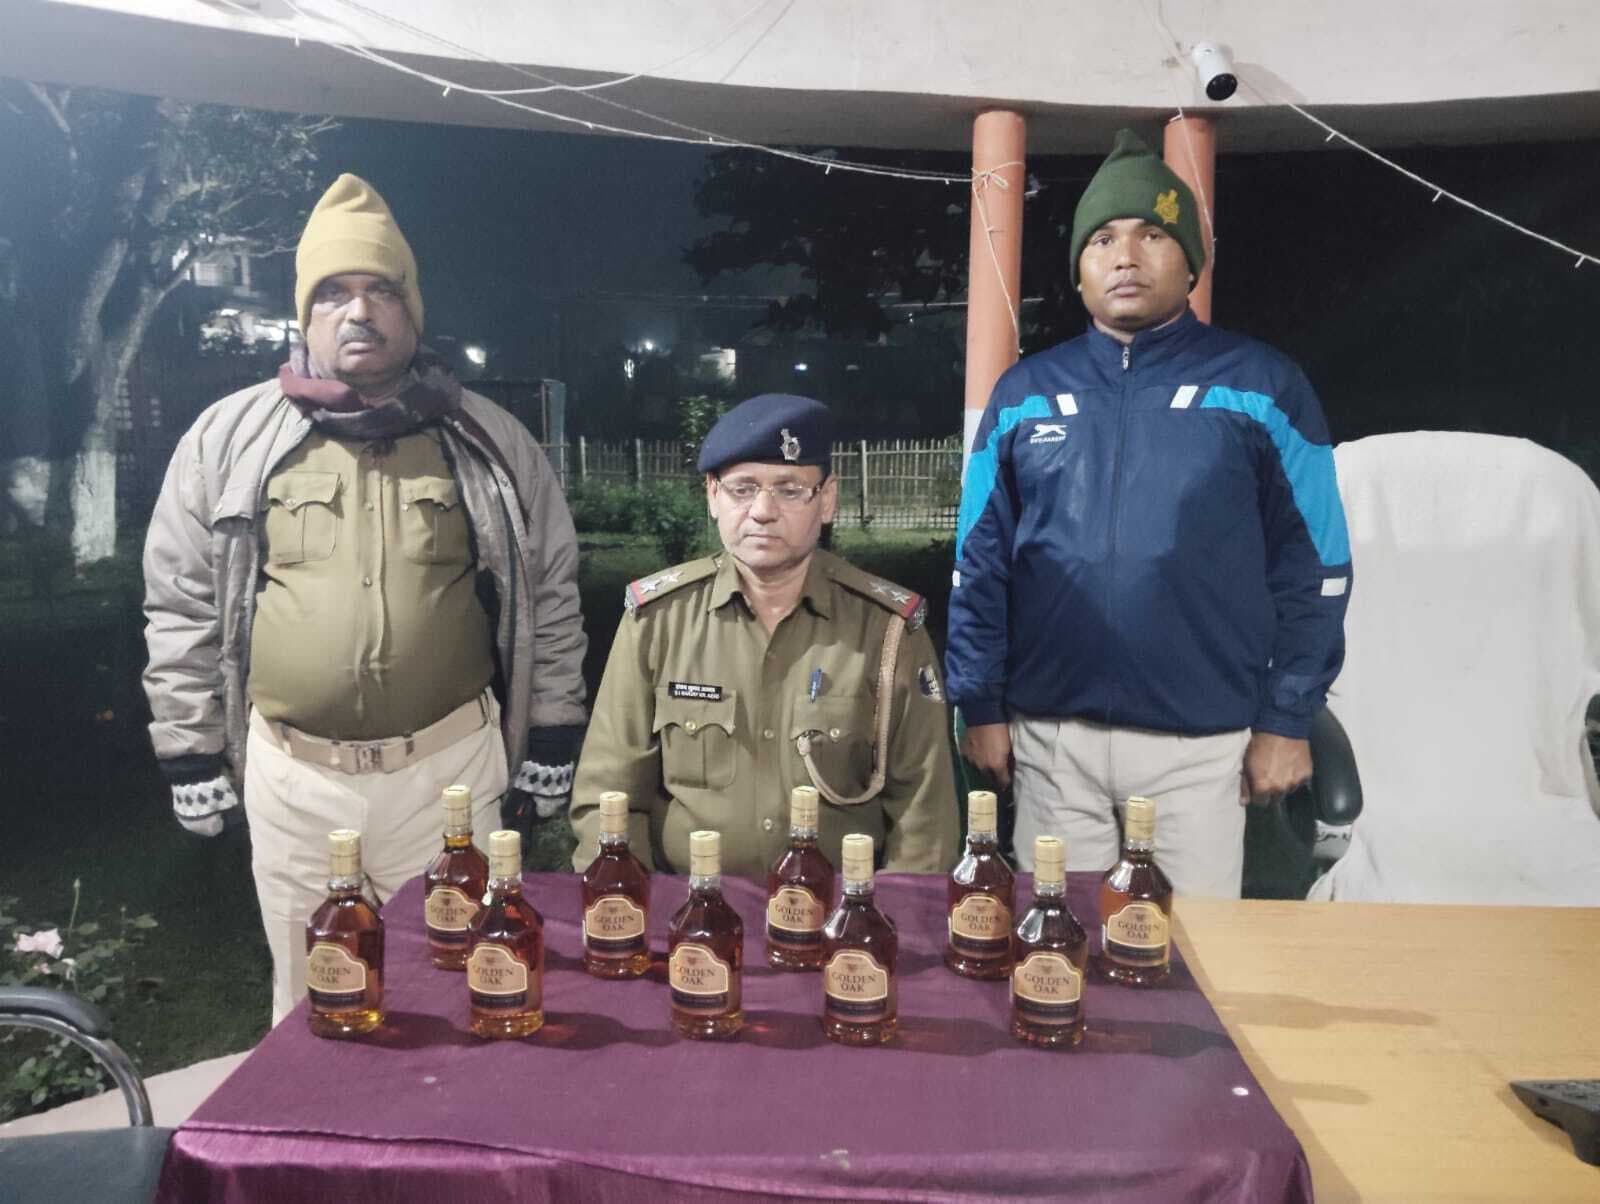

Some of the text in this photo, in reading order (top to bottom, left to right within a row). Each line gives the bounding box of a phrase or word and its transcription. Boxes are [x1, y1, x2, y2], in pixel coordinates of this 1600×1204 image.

[681, 975, 704, 986] OAK
[832, 972, 875, 984] GOLDEN
[1024, 972, 1070, 986] GOLDEN
[840, 982, 864, 993] OAK
[1033, 984, 1059, 995] OAK
